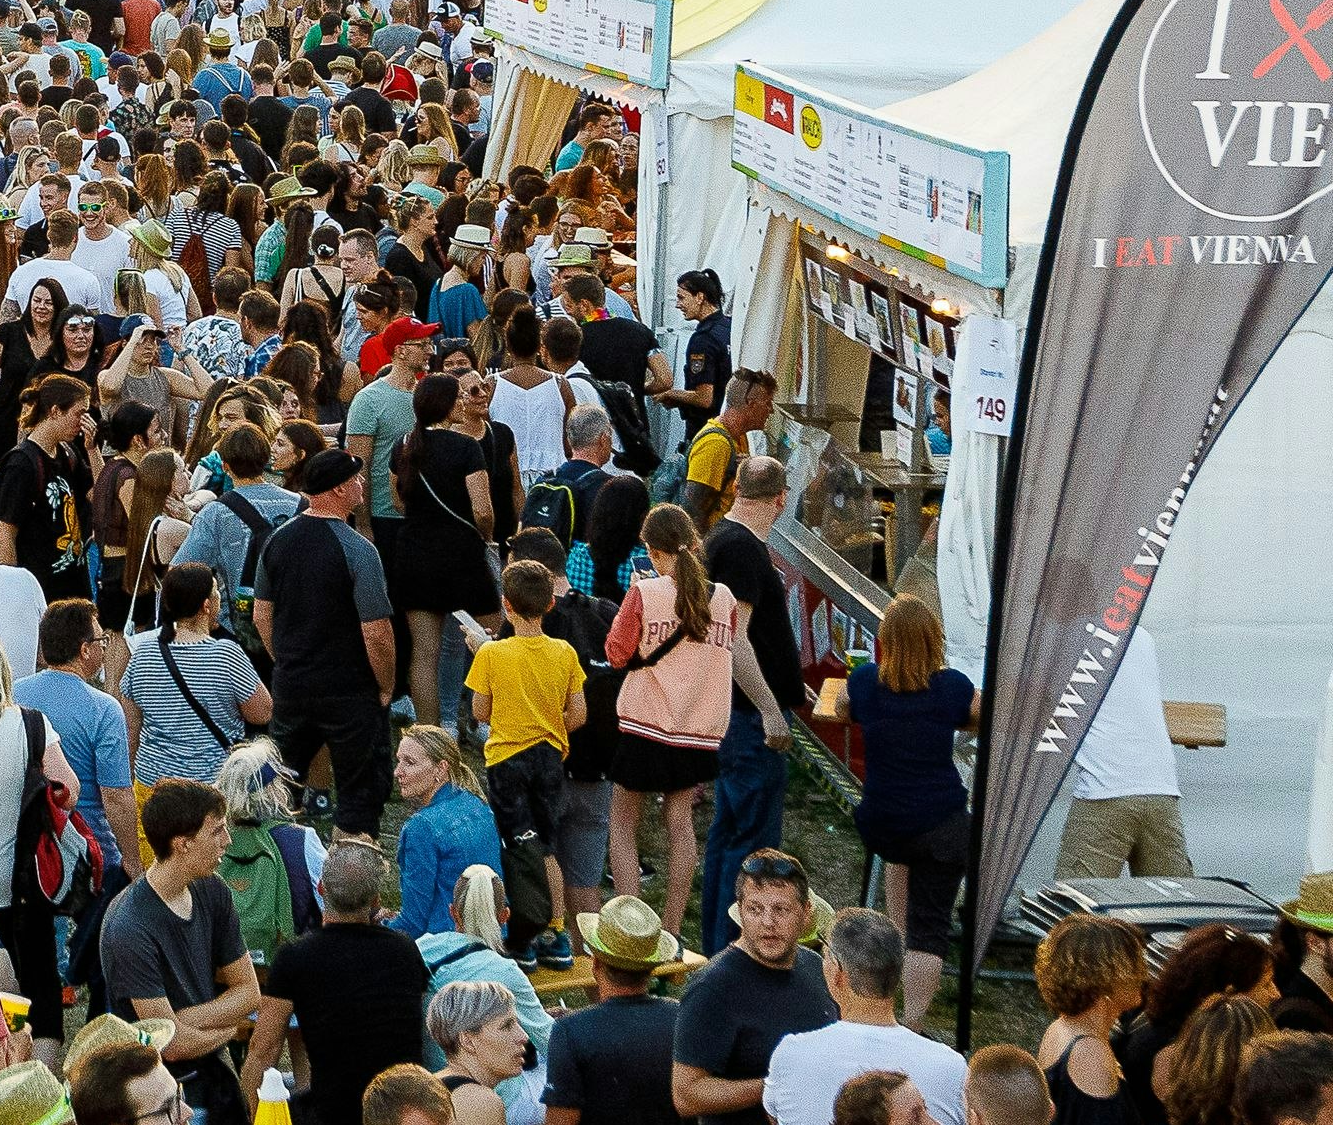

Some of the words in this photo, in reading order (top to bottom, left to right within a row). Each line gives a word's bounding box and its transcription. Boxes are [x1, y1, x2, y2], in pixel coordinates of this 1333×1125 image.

[1092, 238, 1109, 268] I
[1116, 235, 1181, 268] EAT
[1190, 234, 1317, 267] VIENNA
[976, 395, 1006, 423] 149
